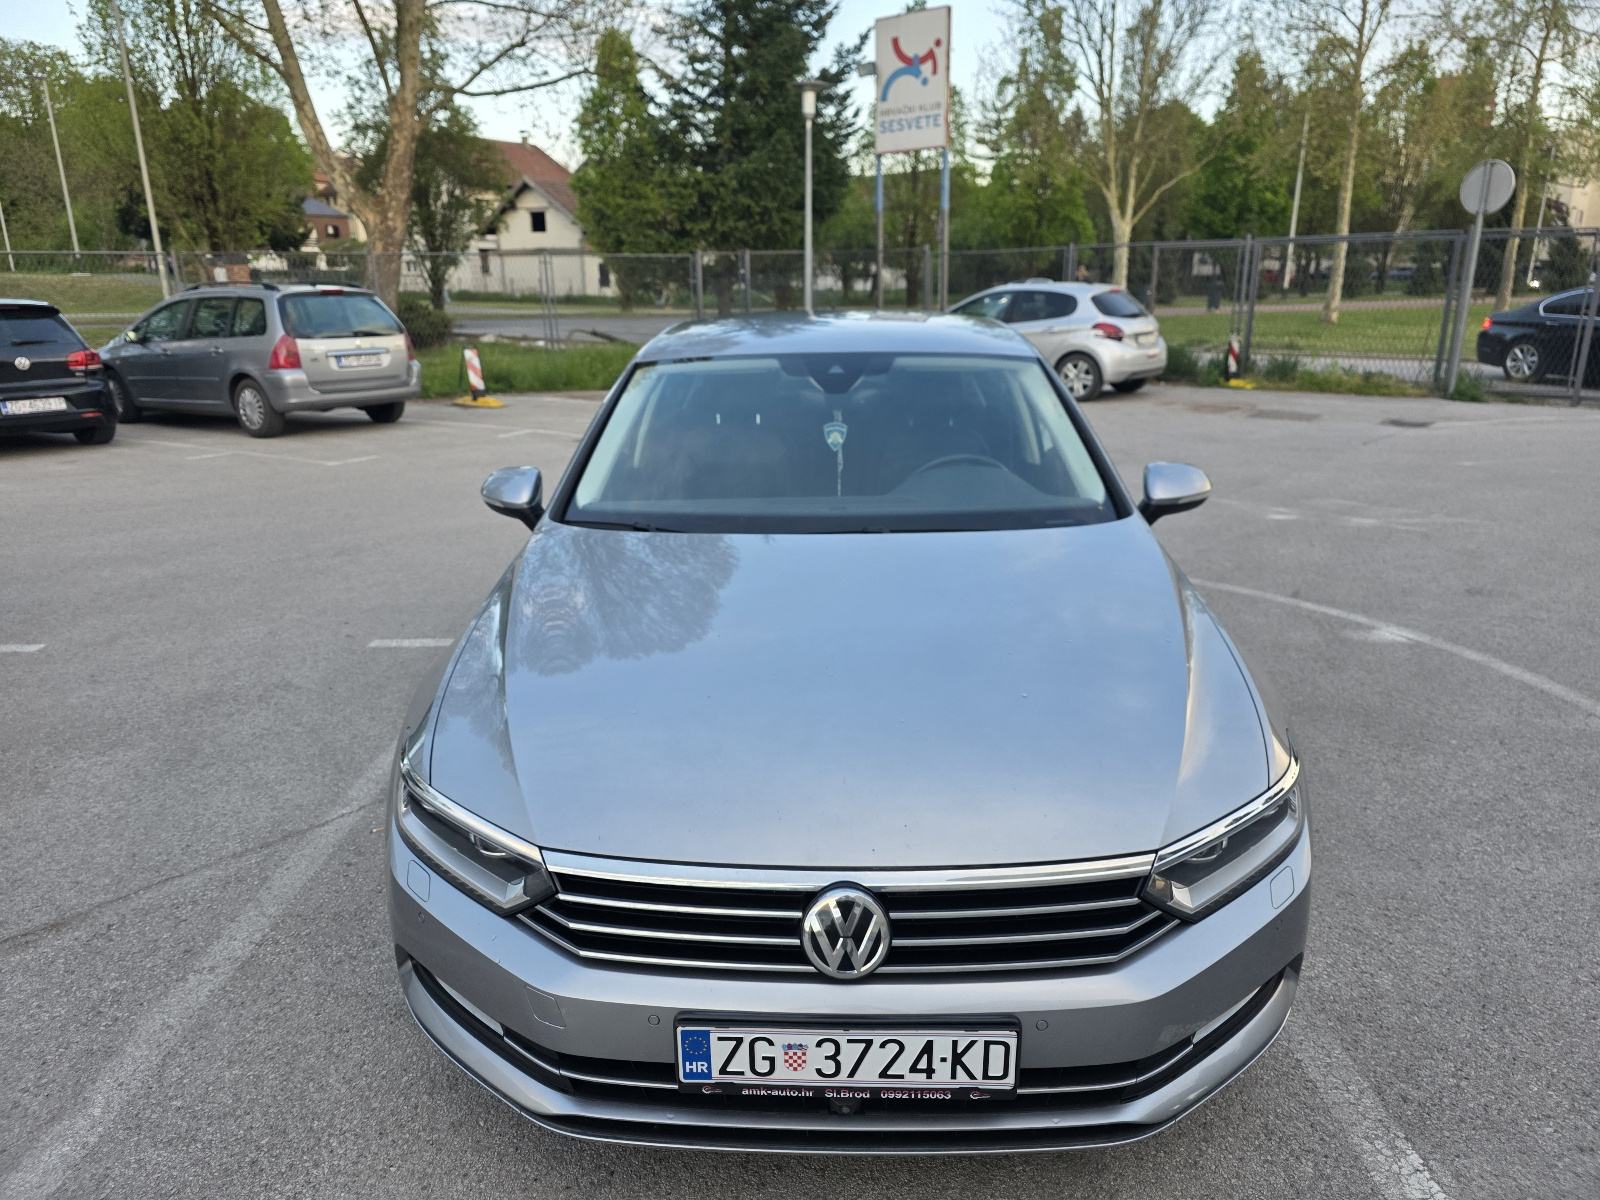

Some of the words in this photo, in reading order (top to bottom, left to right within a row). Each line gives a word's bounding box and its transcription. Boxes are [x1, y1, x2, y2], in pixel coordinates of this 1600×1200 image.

[879, 112, 942, 134] SESVETE
[717, 1036, 776, 1077] ZG
[685, 1061, 708, 1073] HR
[741, 1086, 815, 1098] amk-auto.hr
[880, 1089, 952, 1100] 0992115063
